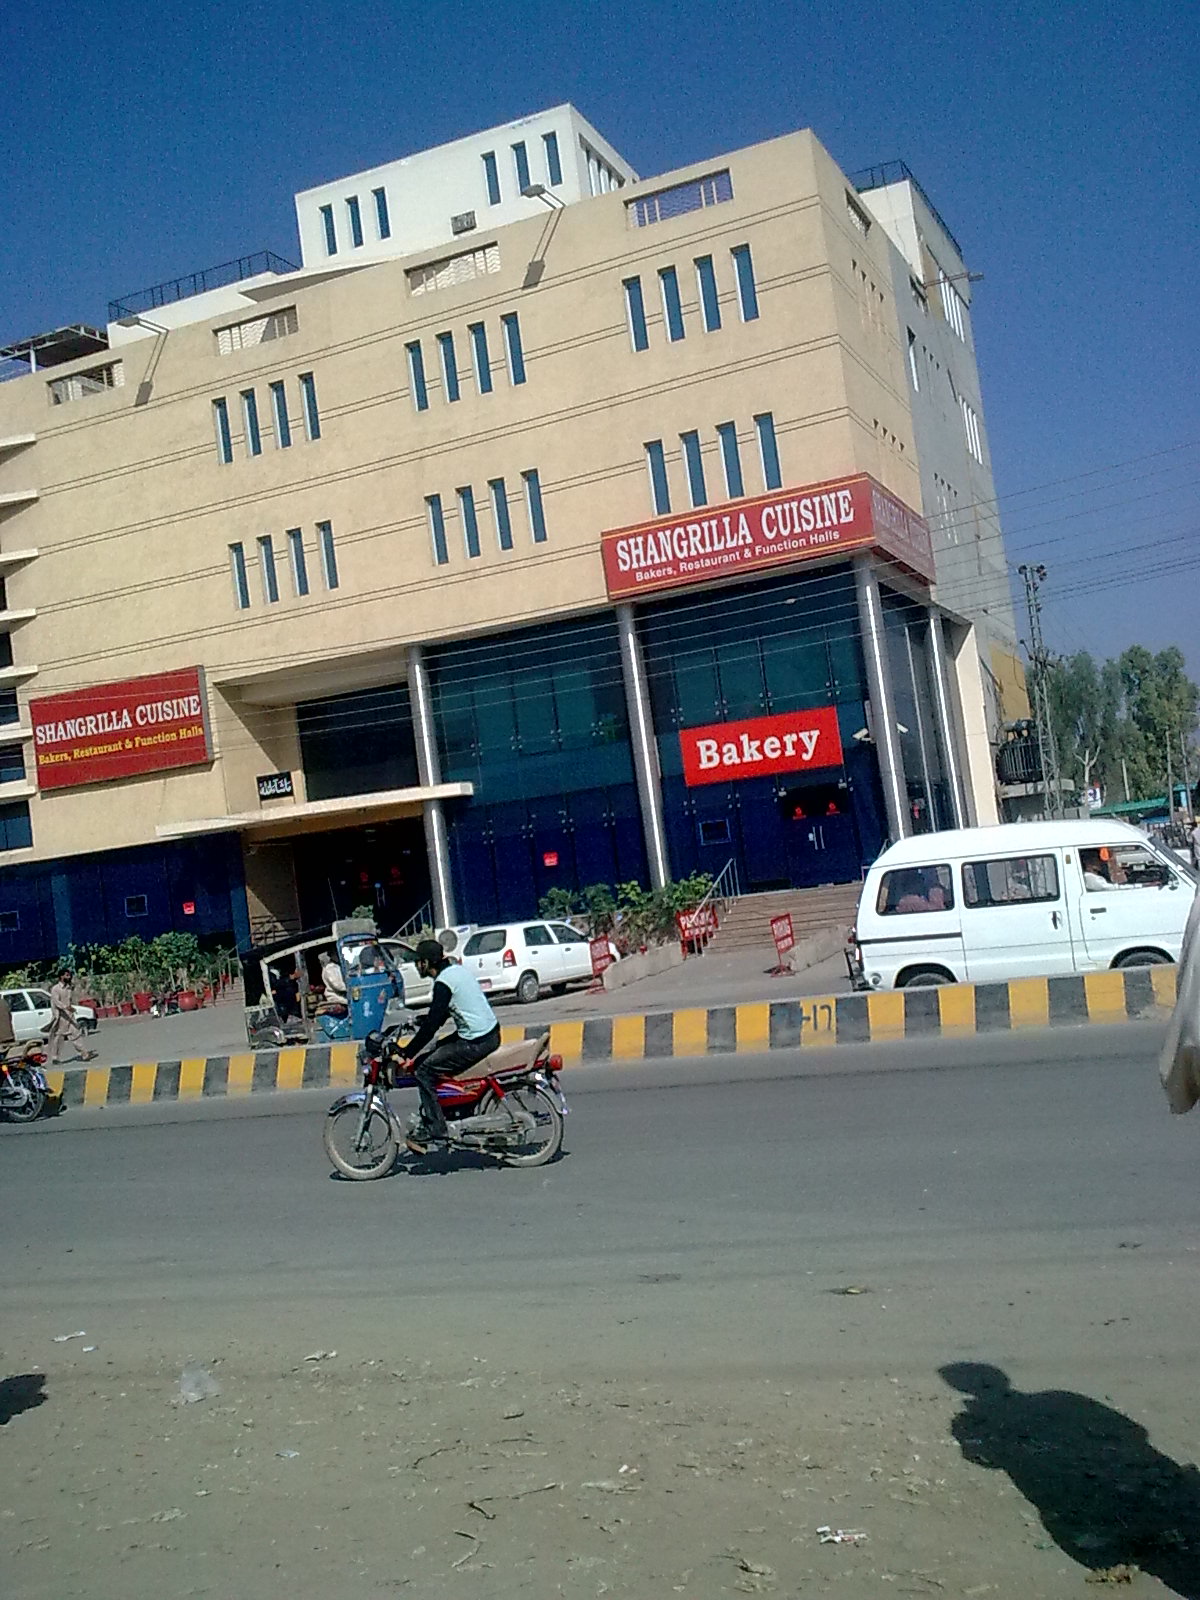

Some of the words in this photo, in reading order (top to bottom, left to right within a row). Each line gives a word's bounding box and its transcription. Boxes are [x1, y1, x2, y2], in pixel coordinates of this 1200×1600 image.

[616, 512, 753, 572] SHANGRILLA
[761, 489, 855, 540] CUISINE
[635, 566, 677, 582] Bakers,
[679, 551, 741, 573] Restaurant
[743, 548, 752, 559] &
[755, 538, 807, 556] Function
[809, 530, 840, 545] Halls
[35, 708, 133, 745] SHANGRILLA
[135, 694, 201, 726] CUISINE
[38, 752, 72, 765] Bakers,
[73, 740, 123, 759] Restaurant
[124, 738, 133, 749] &
[134, 731, 178, 748] Function
[178, 725, 204, 740] Halls
[696, 729, 821, 770] Bakery
